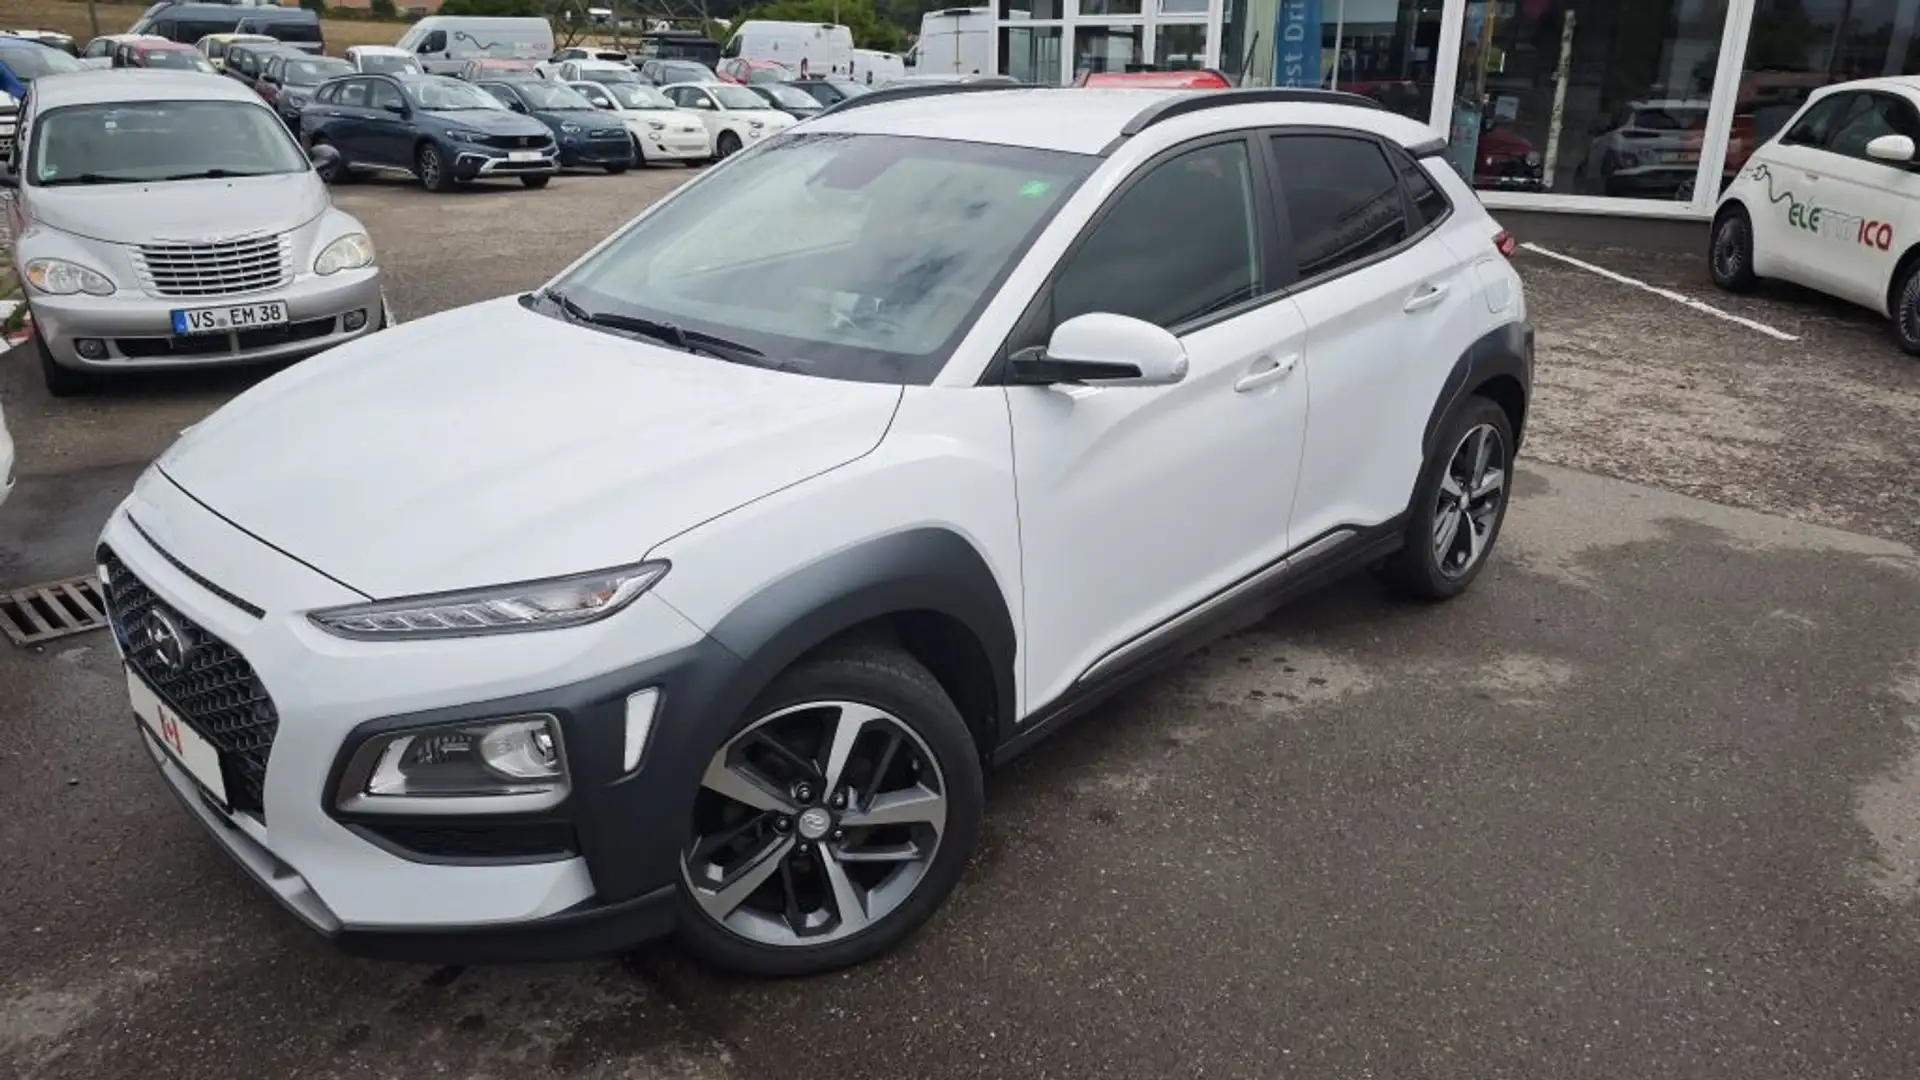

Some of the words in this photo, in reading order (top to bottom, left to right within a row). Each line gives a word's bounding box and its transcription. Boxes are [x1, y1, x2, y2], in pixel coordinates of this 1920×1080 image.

[189, 311, 215, 329] VS
[230, 308, 256, 325] EM
[259, 304, 281, 322] 38
